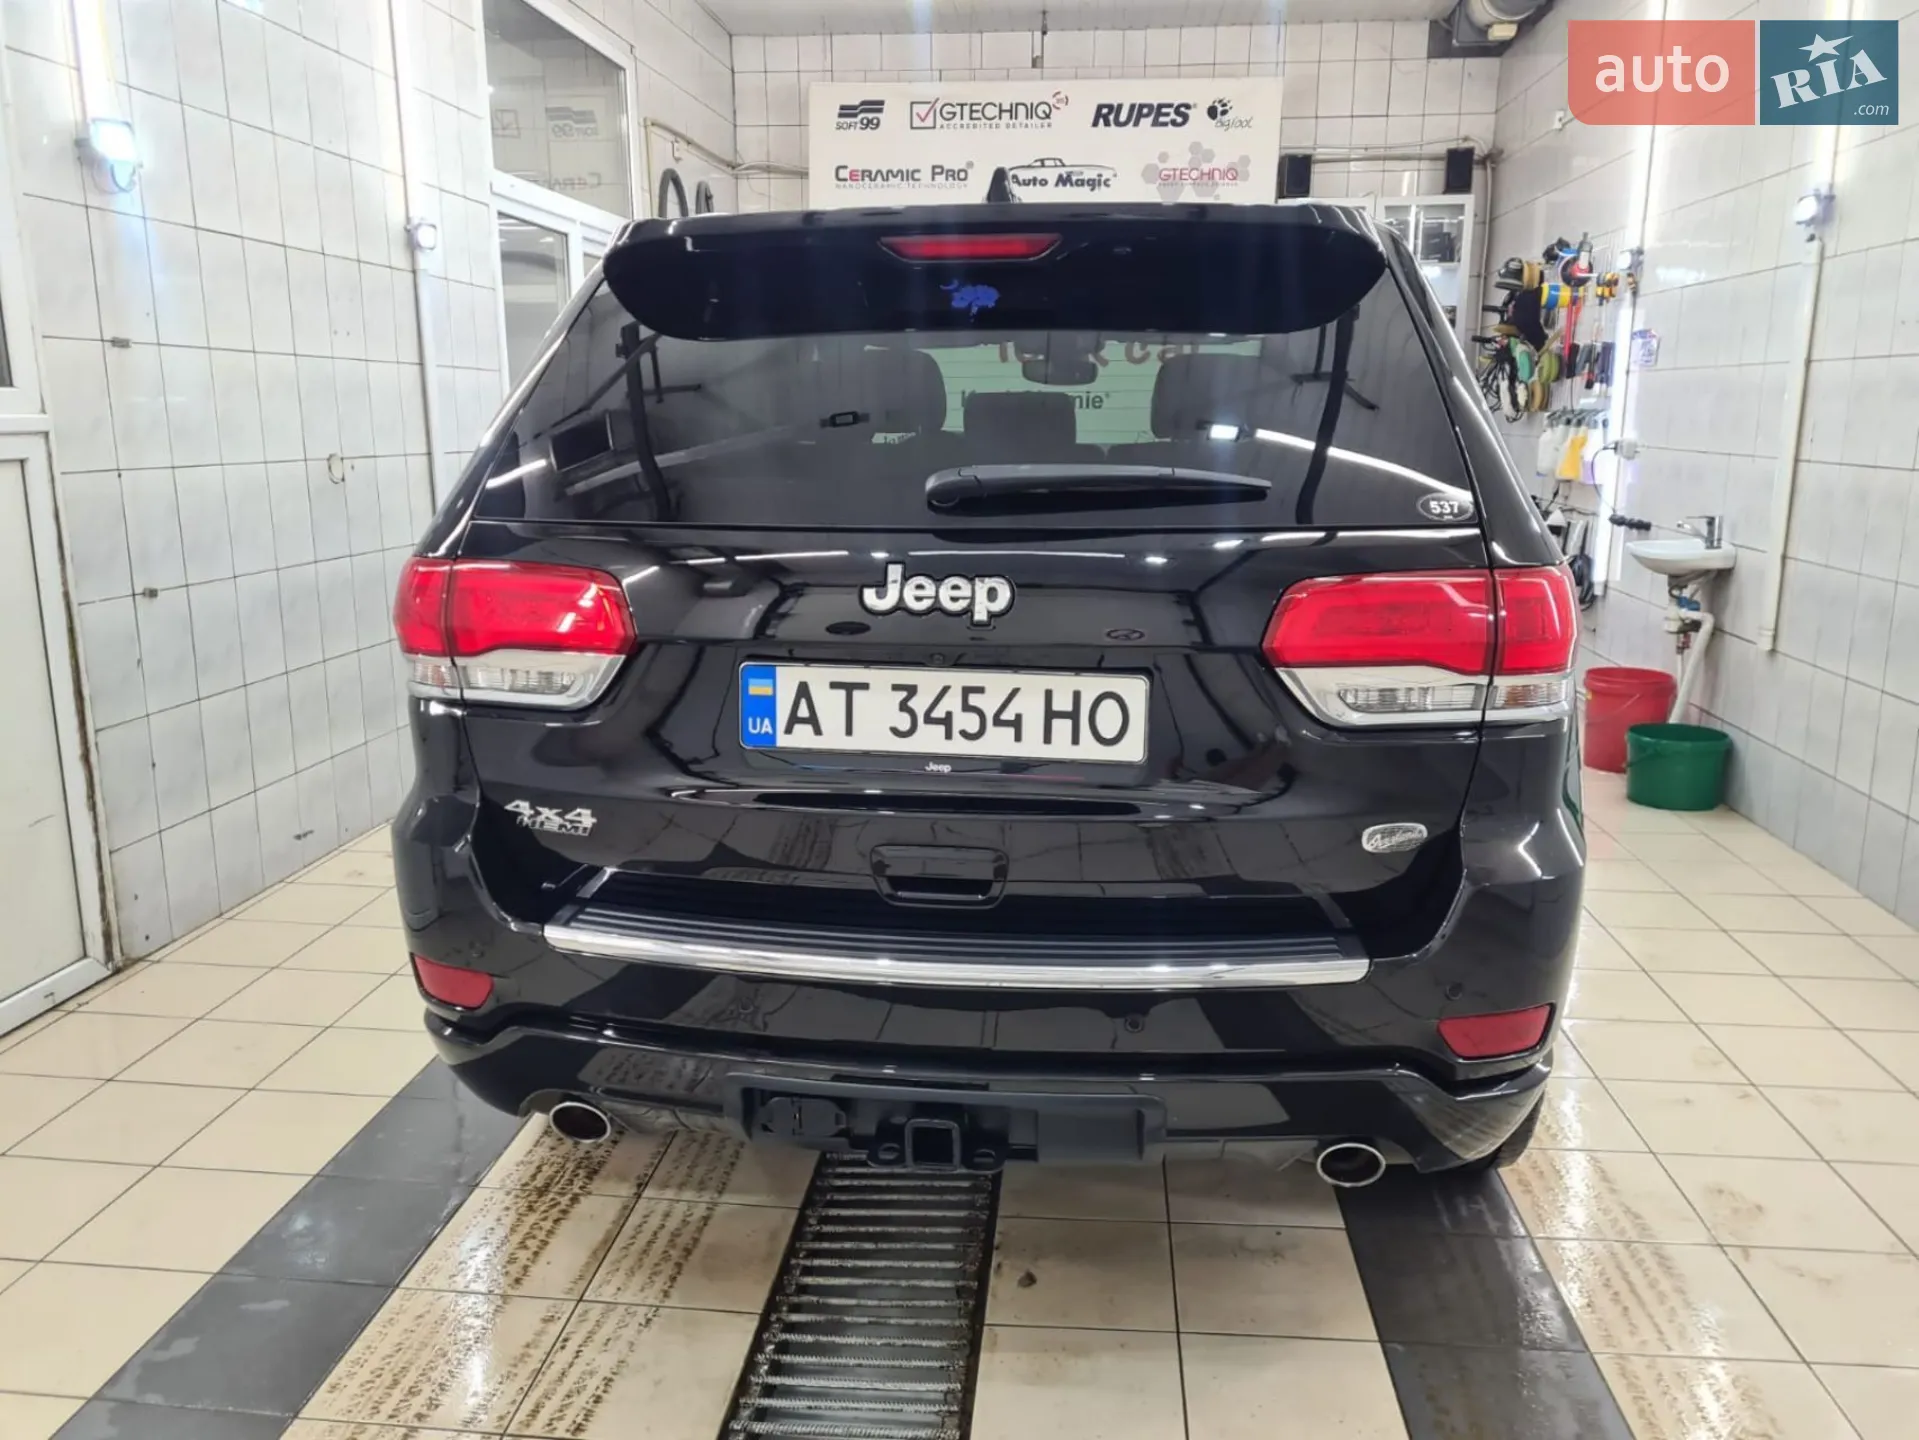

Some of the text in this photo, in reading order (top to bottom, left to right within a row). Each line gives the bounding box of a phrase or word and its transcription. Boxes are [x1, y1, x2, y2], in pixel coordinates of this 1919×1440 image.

[1090, 102, 1192, 128] RUPES
[1011, 173, 1111, 192] Auto Magic
[1159, 167, 1239, 181] GTECHNIQ
[1429, 500, 1459, 514] 537
[861, 562, 1013, 625] Jeep
[783, 681, 1131, 747] AT 3454 HO
[747, 717, 774, 735] UA
[925, 761, 952, 774] Jeep
[504, 799, 597, 824] 4x4
